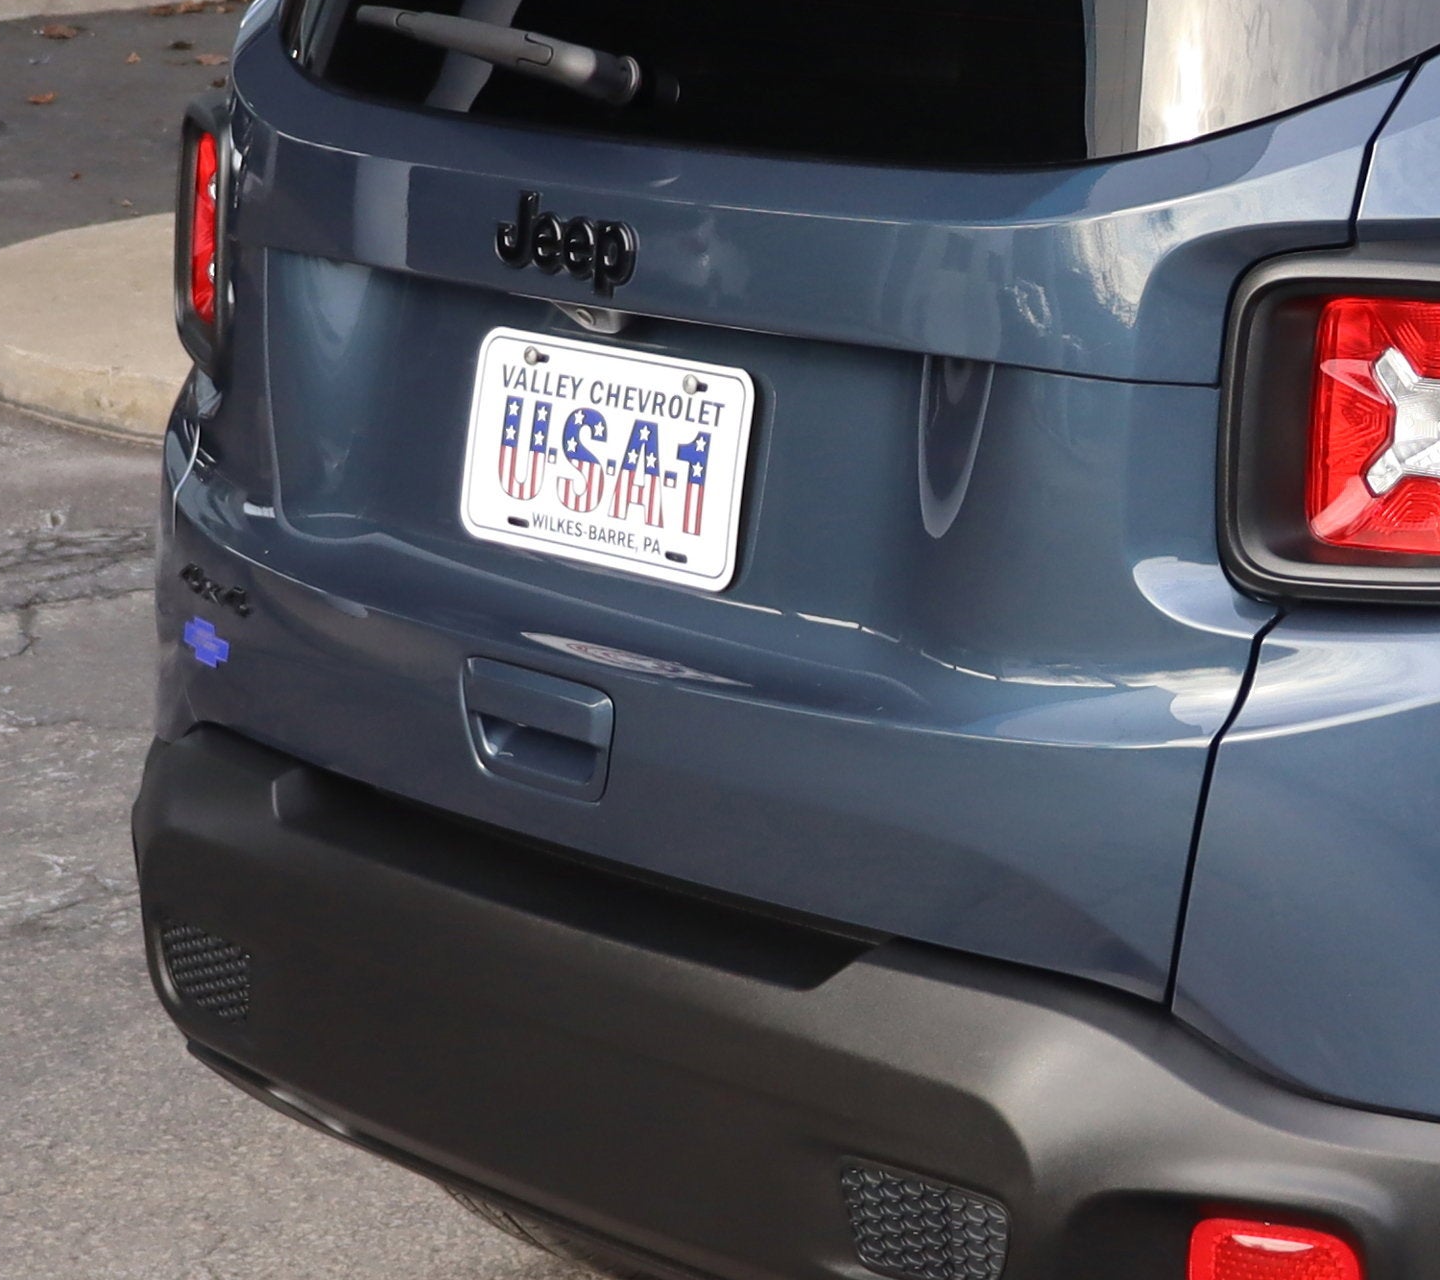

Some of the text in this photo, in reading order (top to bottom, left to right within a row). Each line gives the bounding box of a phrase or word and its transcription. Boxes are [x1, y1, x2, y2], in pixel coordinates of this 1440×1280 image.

[493, 189, 641, 299] Jeep
[502, 363, 726, 427] VALLEY CHEVROLET
[531, 512, 661, 556] WILKES-BARRE, PA
